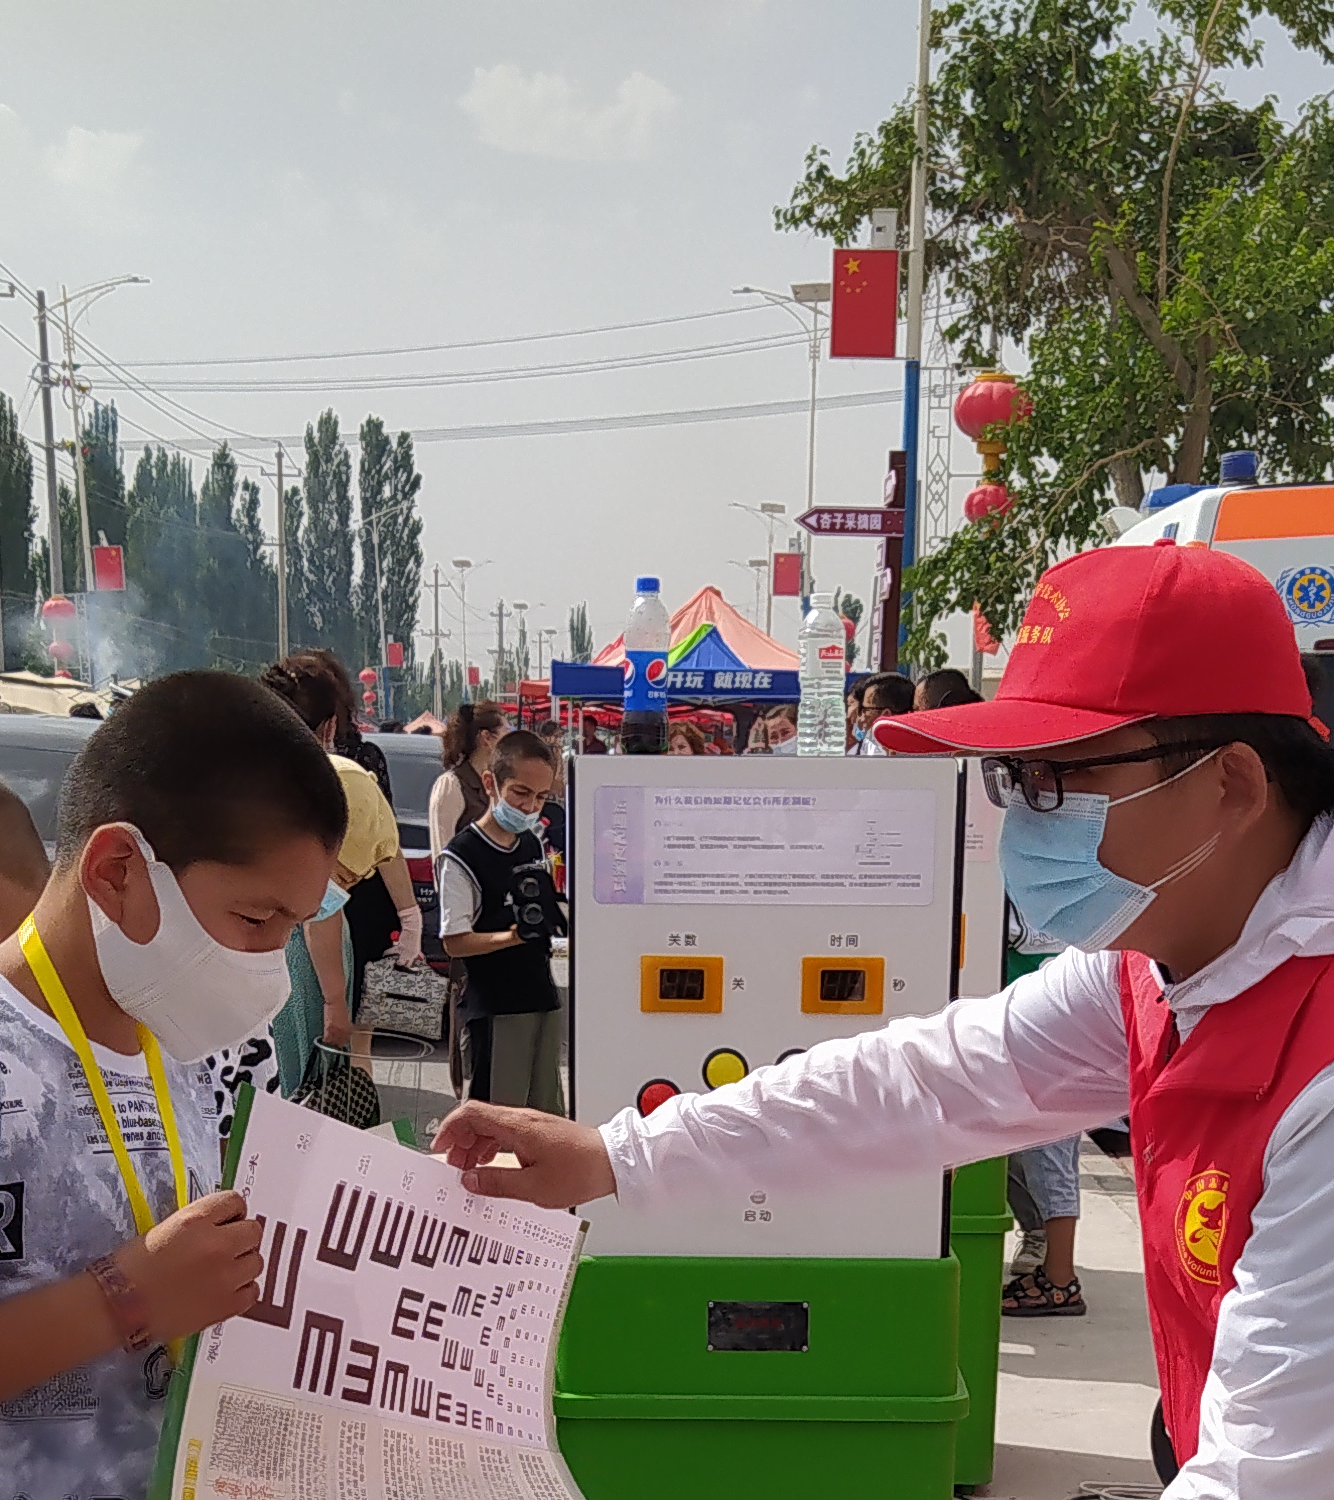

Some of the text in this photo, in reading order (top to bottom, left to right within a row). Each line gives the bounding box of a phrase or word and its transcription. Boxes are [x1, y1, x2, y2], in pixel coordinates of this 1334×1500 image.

[820, 512, 882, 531] 杏子采摘园
[714, 671, 772, 689] 就现在
[667, 934, 698, 948] 关数
[829, 935, 859, 948] 时间
[732, 978, 745, 991] 关
[893, 979, 906, 991] 秒
[744, 1210, 772, 1223] 启动
